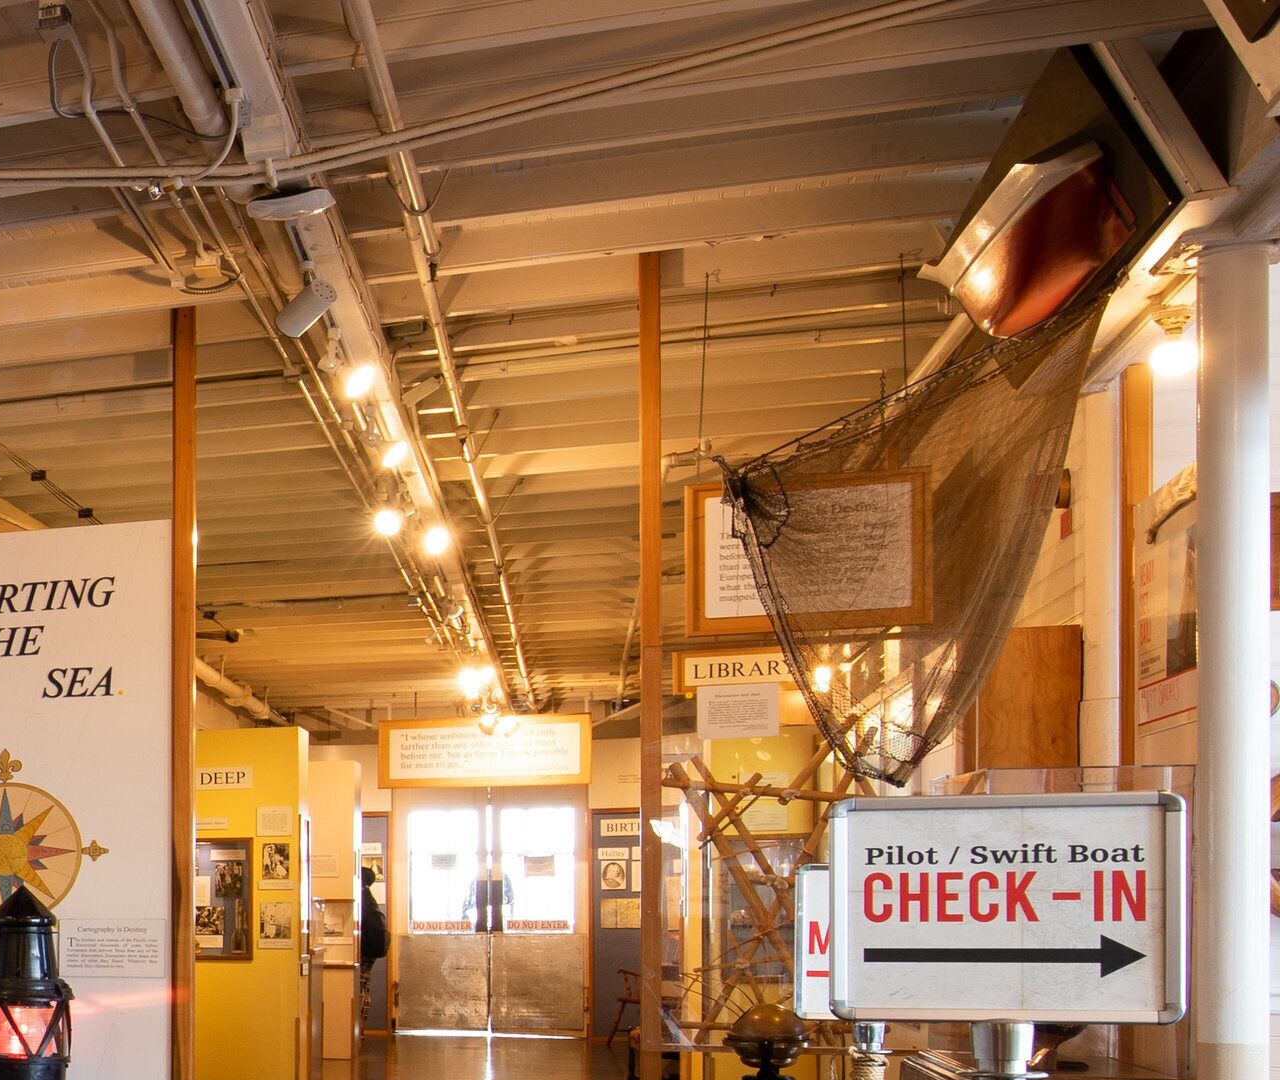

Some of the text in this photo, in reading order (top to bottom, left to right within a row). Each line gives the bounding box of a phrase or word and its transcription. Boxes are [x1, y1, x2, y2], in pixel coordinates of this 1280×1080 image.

[41, 667, 115, 700] SEA
[440, 732, 477, 740] ambition
[400, 743, 429, 751] farther
[431, 742, 451, 750] than
[400, 752, 426, 760] before
[400, 762, 413, 770] for
[200, 772, 246, 785] DEEP
[864, 843, 1145, 866] Pilot / Swift Boat
[863, 871, 1038, 923] CHECK
[1093, 870, 1147, 922] IN
[413, 921, 471, 930] DO NOT ENTER
[508, 920, 568, 929] DO NOT ENTER
